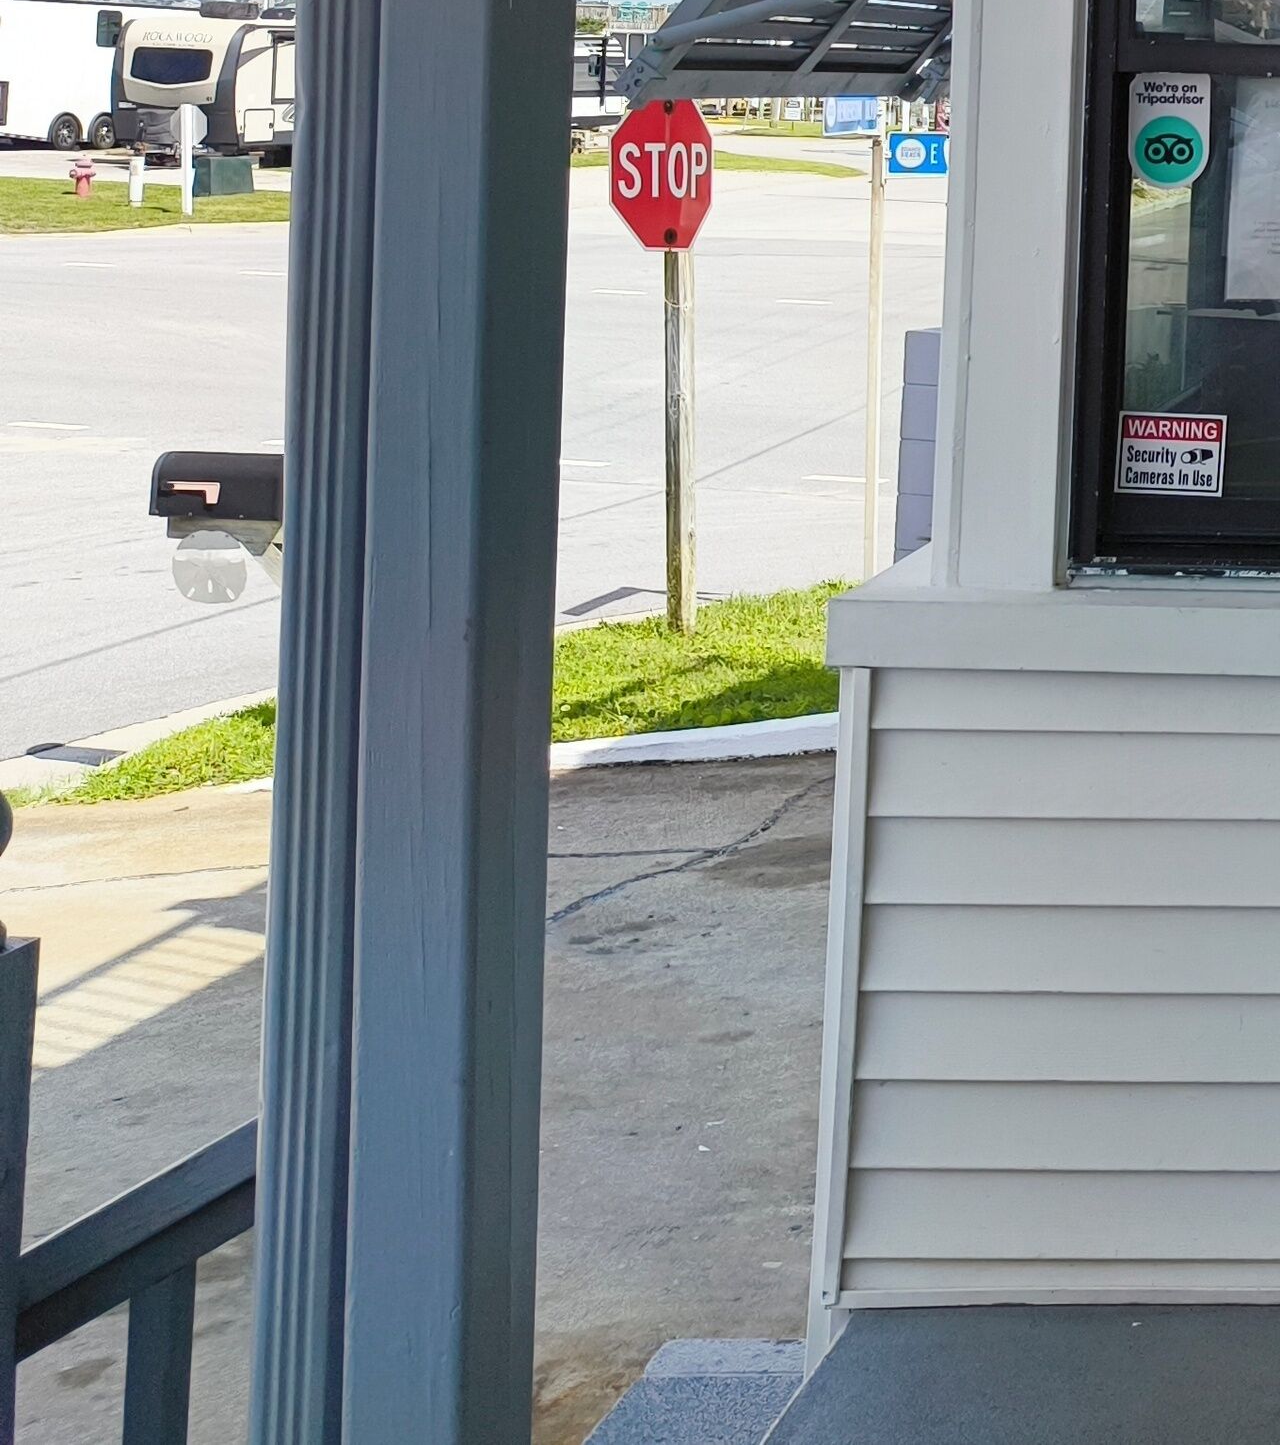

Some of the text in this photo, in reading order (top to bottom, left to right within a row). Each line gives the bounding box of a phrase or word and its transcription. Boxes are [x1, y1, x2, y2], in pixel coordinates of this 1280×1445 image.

[1143, 82, 1197, 93] We're on
[1136, 93, 1205, 106] Tripadvisor
[617, 141, 708, 199] STOP
[1128, 419, 1218, 440] WARNING
[1127, 445, 1177, 468] Security
[1125, 466, 1213, 487] Cameras In Use
